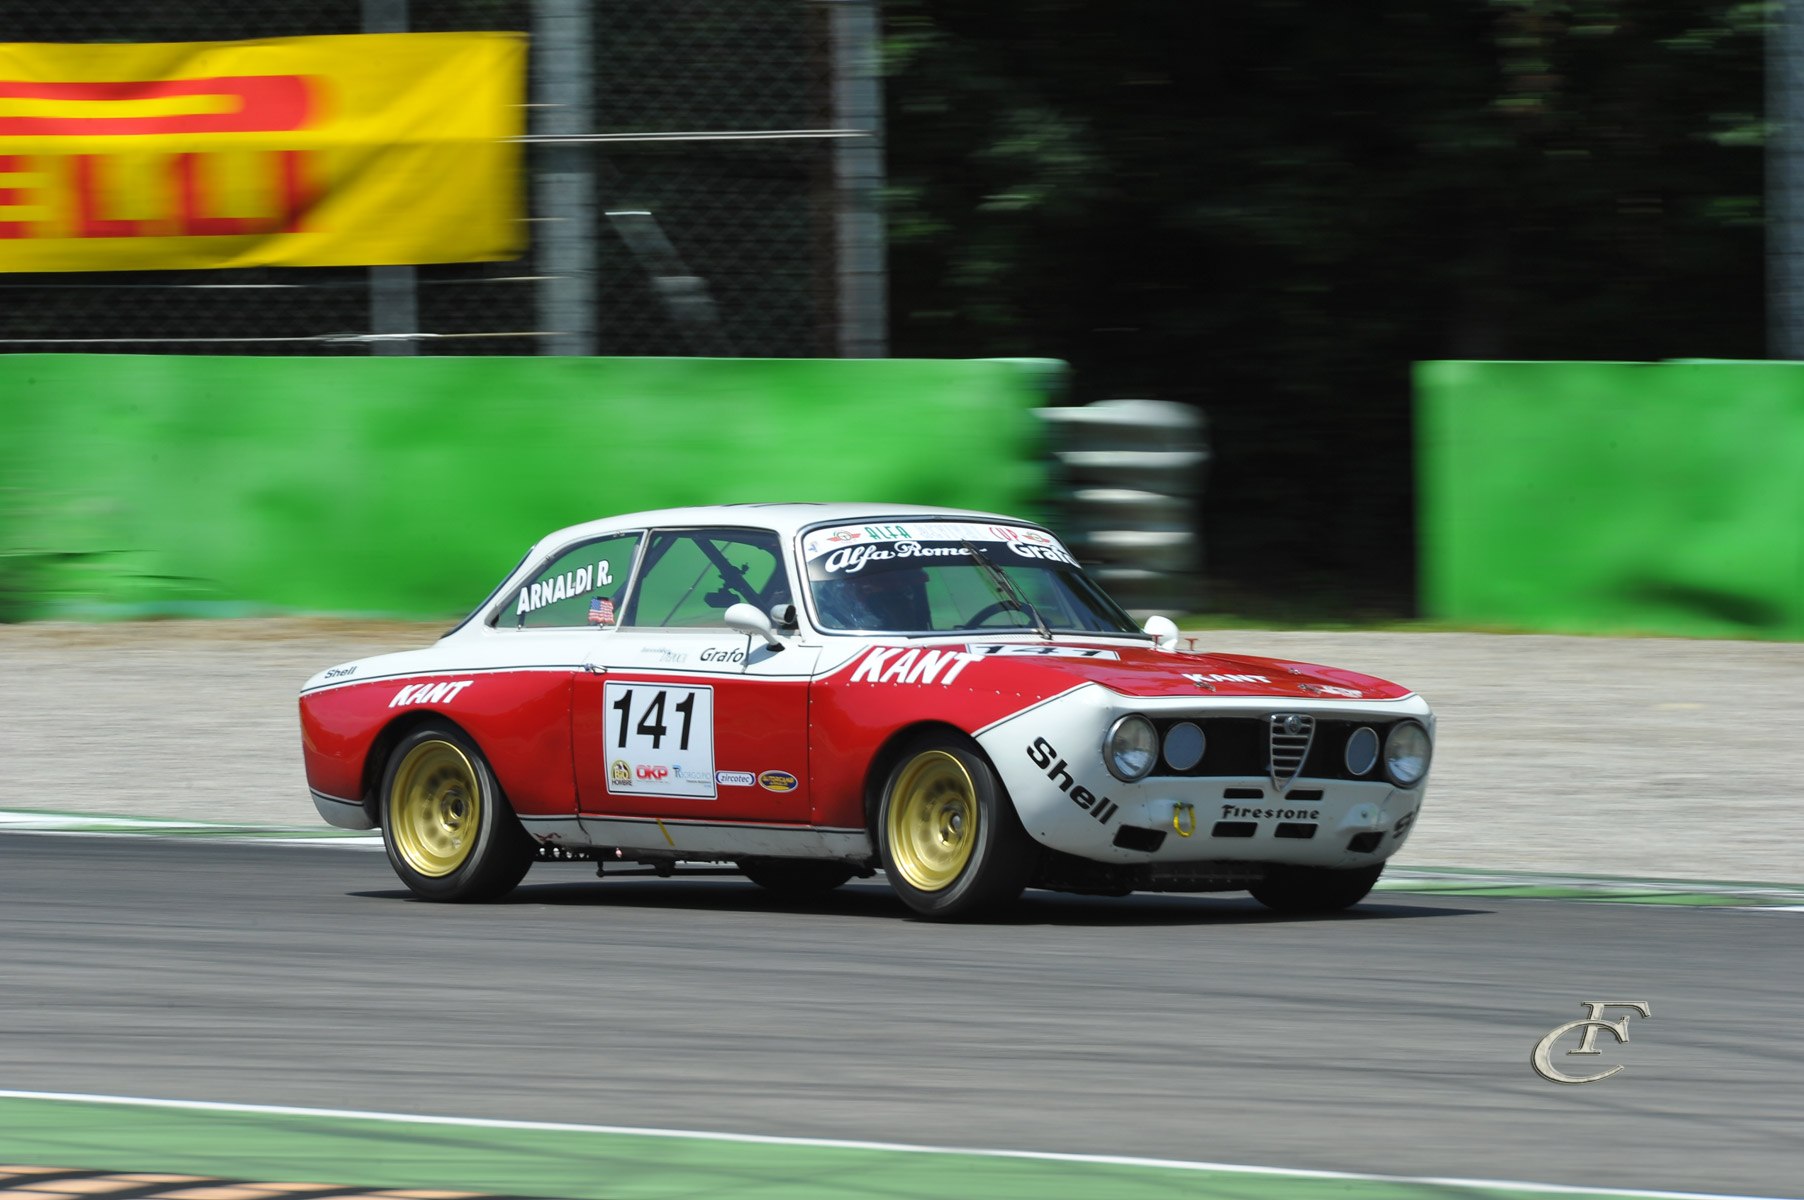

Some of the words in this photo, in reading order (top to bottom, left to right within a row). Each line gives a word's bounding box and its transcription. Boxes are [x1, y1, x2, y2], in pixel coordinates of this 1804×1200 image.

[863, 525, 912, 540] ALFA
[824, 544, 896, 573] Alfa
[893, 540, 988, 558] Rome
[516, 564, 594, 615] ARNALDI
[596, 559, 613, 587] R.
[699, 647, 745, 663] Grafo
[324, 666, 357, 679] Shell
[849, 646, 986, 686] KANT
[1181, 673, 1272, 684] KANT
[387, 680, 475, 708] KANT
[612, 688, 696, 751] 141
[636, 764, 669, 780] OKP
[720, 774, 750, 783] zircotec
[1026, 736, 1119, 825] Shell
[1221, 804, 1321, 820] Firestone
